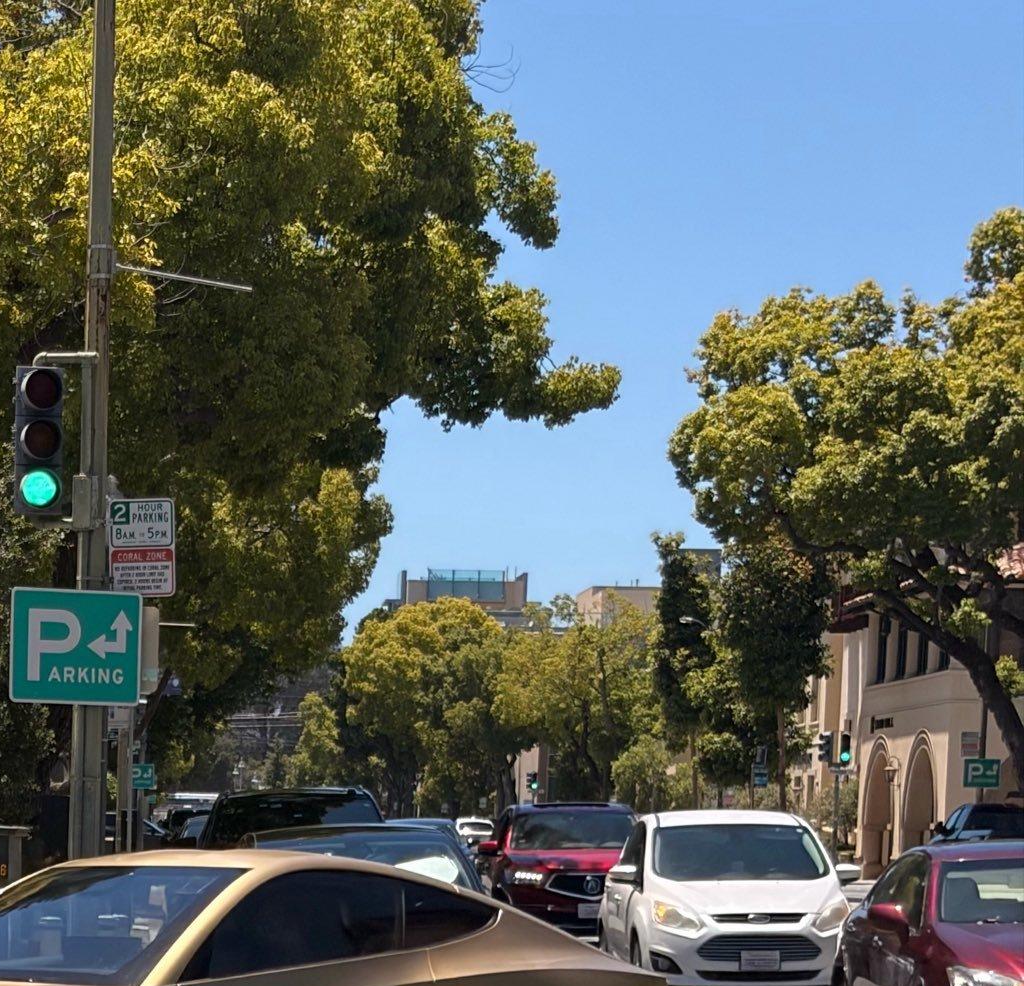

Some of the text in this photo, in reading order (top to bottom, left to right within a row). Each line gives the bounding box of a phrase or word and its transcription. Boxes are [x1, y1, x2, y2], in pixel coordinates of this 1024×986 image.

[114, 503, 163, 522] 2 HOUR
[132, 512, 169, 524] PARKING
[117, 551, 167, 562] CORAL ZONE
